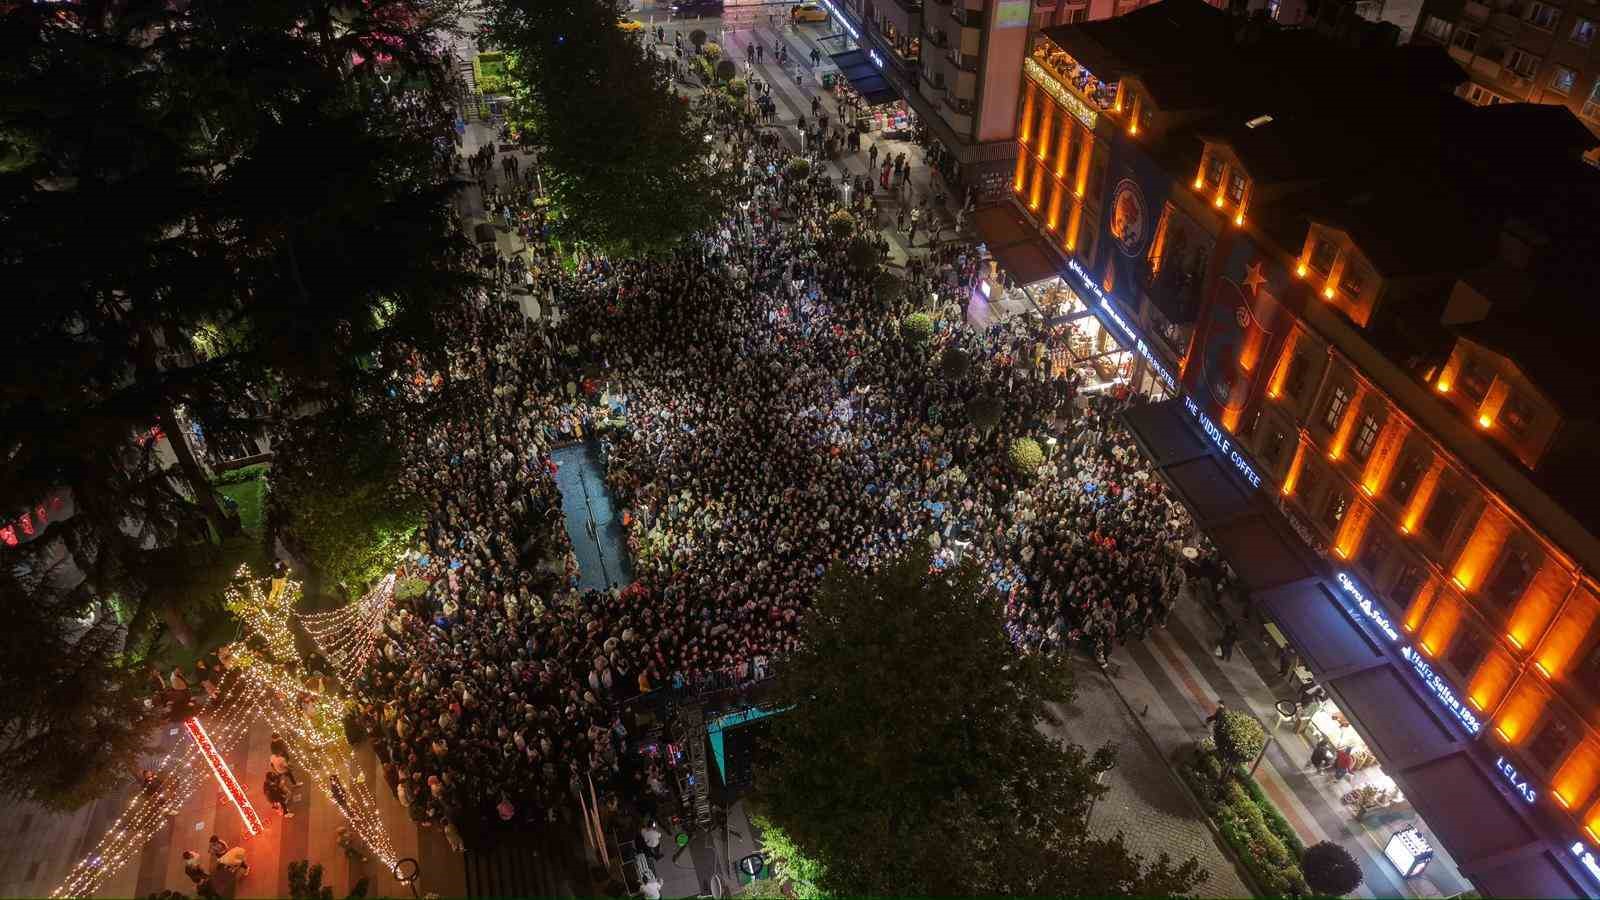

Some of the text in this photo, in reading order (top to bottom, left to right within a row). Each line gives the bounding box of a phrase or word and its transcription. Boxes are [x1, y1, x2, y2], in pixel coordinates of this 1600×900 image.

[1185, 395, 1262, 488] THE MIDDLE COFFEE
[1432, 675, 1460, 709] Sultan
[1459, 706, 1481, 732] 1896
[1496, 756, 1536, 802] LELAS
